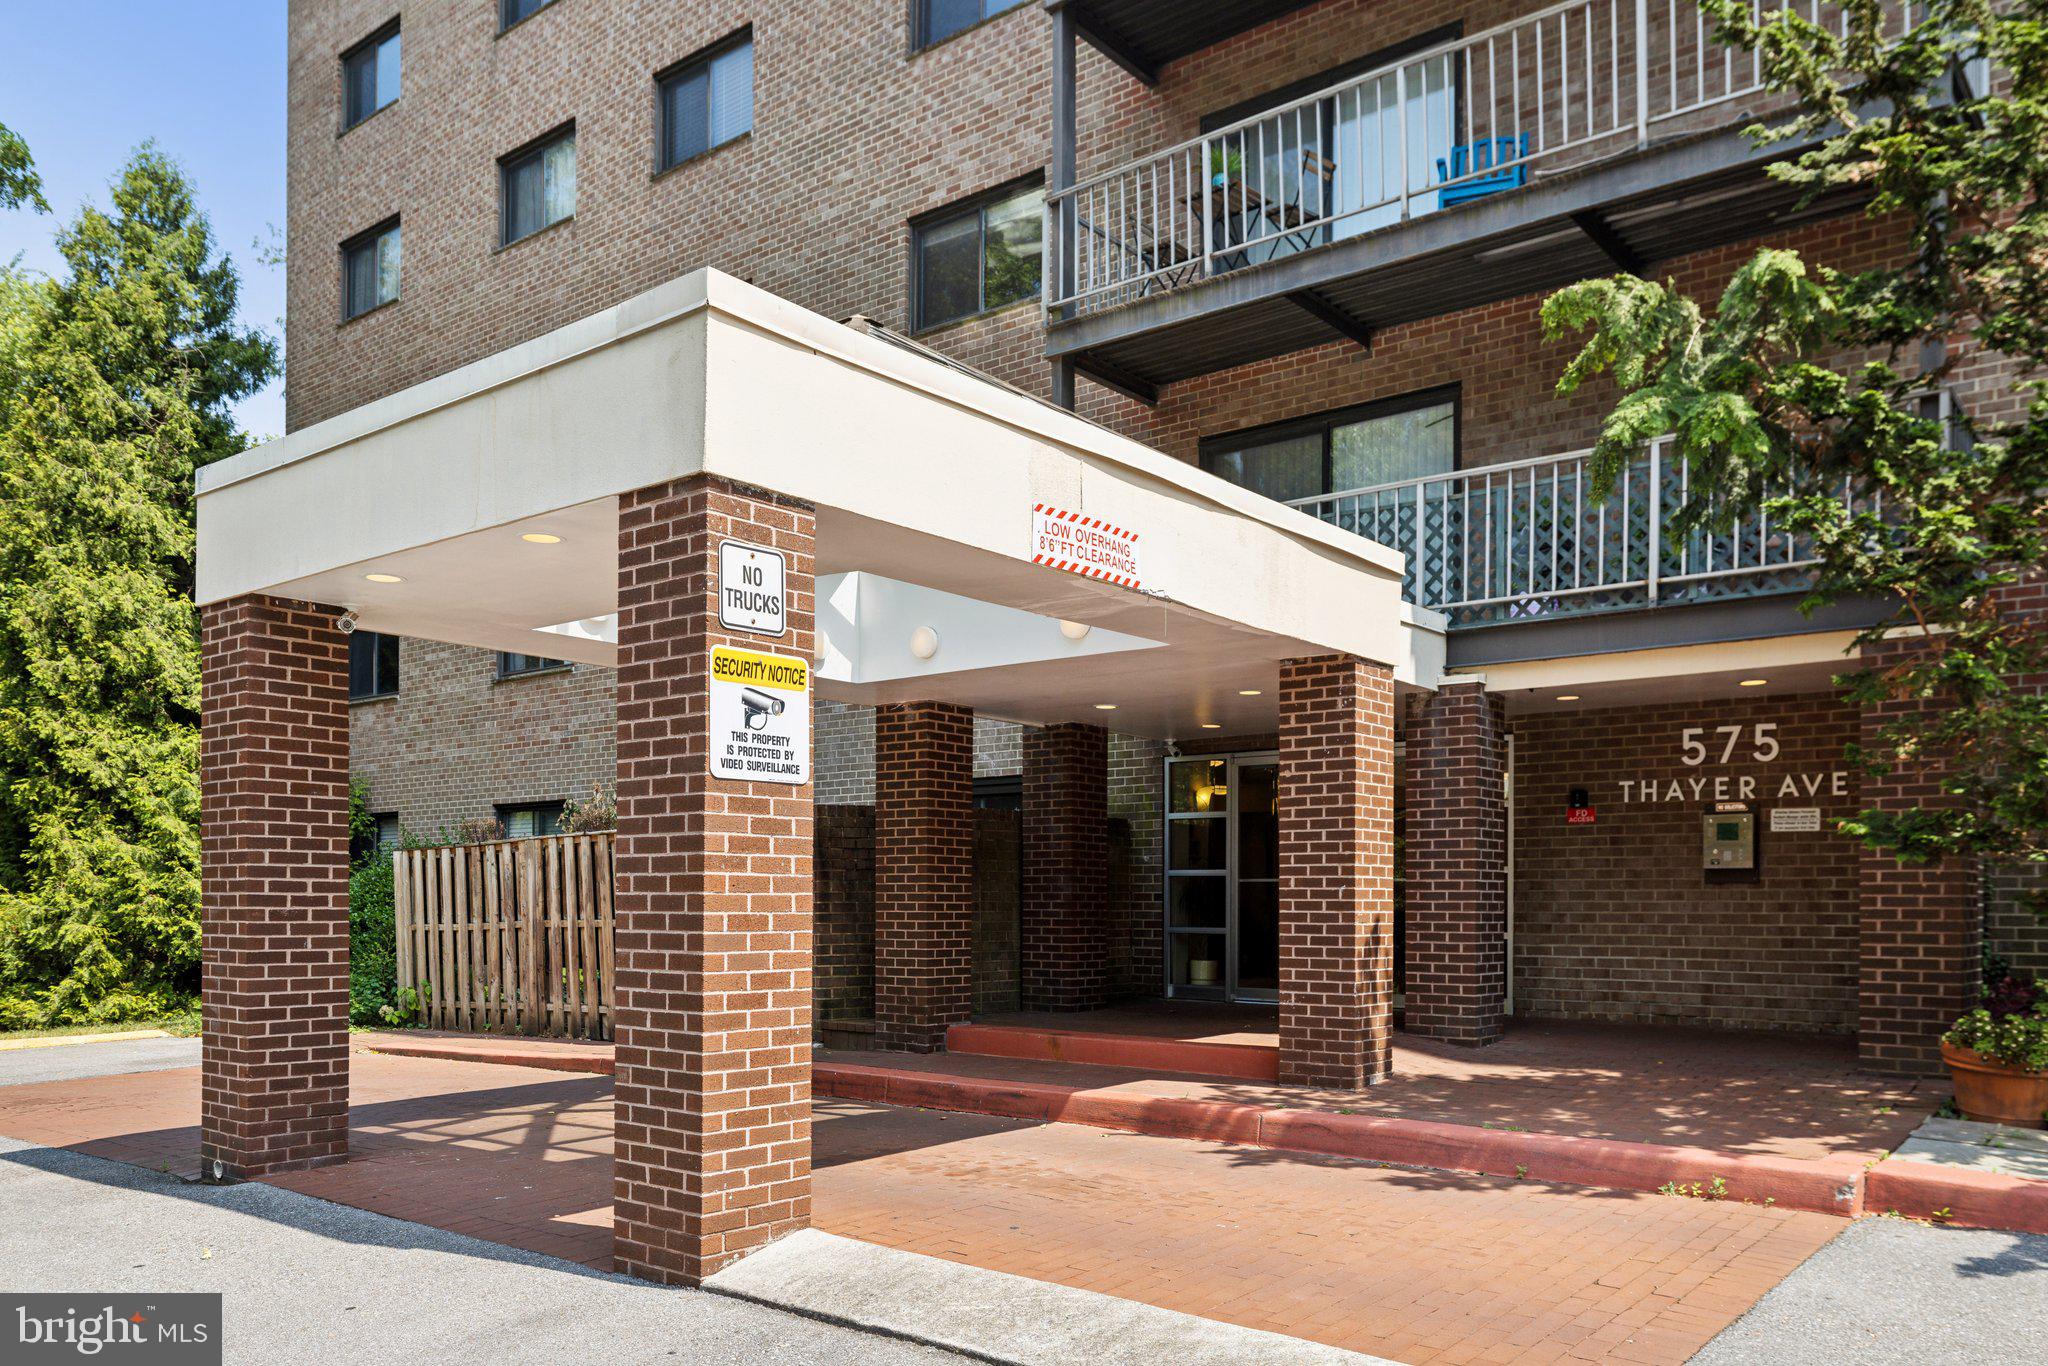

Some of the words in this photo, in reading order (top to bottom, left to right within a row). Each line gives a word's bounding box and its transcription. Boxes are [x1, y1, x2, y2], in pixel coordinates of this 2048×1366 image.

[1044, 520, 1071, 540] LOW
[1075, 528, 1131, 558] OVERHANG
[1076, 545, 1137, 575] CLEARANCE
[742, 565, 763, 587] NO
[725, 587, 780, 616] TRUCKS
[713, 655, 767, 682] SECURITY
[768, 664, 805, 686] NOTICE
[726, 744, 735, 756] IS
[737, 745, 781, 760] PROTECTED
[784, 750, 795, 761] BY
[731, 731, 748, 744] THIS
[751, 732, 791, 747] PROPERTY
[1680, 723, 1780, 766] 575
[720, 757, 744, 771] VIDEO
[746, 759, 801, 775] SURVEILLANCE
[1618, 776, 1756, 803] THAYER
[1777, 771, 1849, 798] AVE
[1575, 809, 1588, 817] FD
